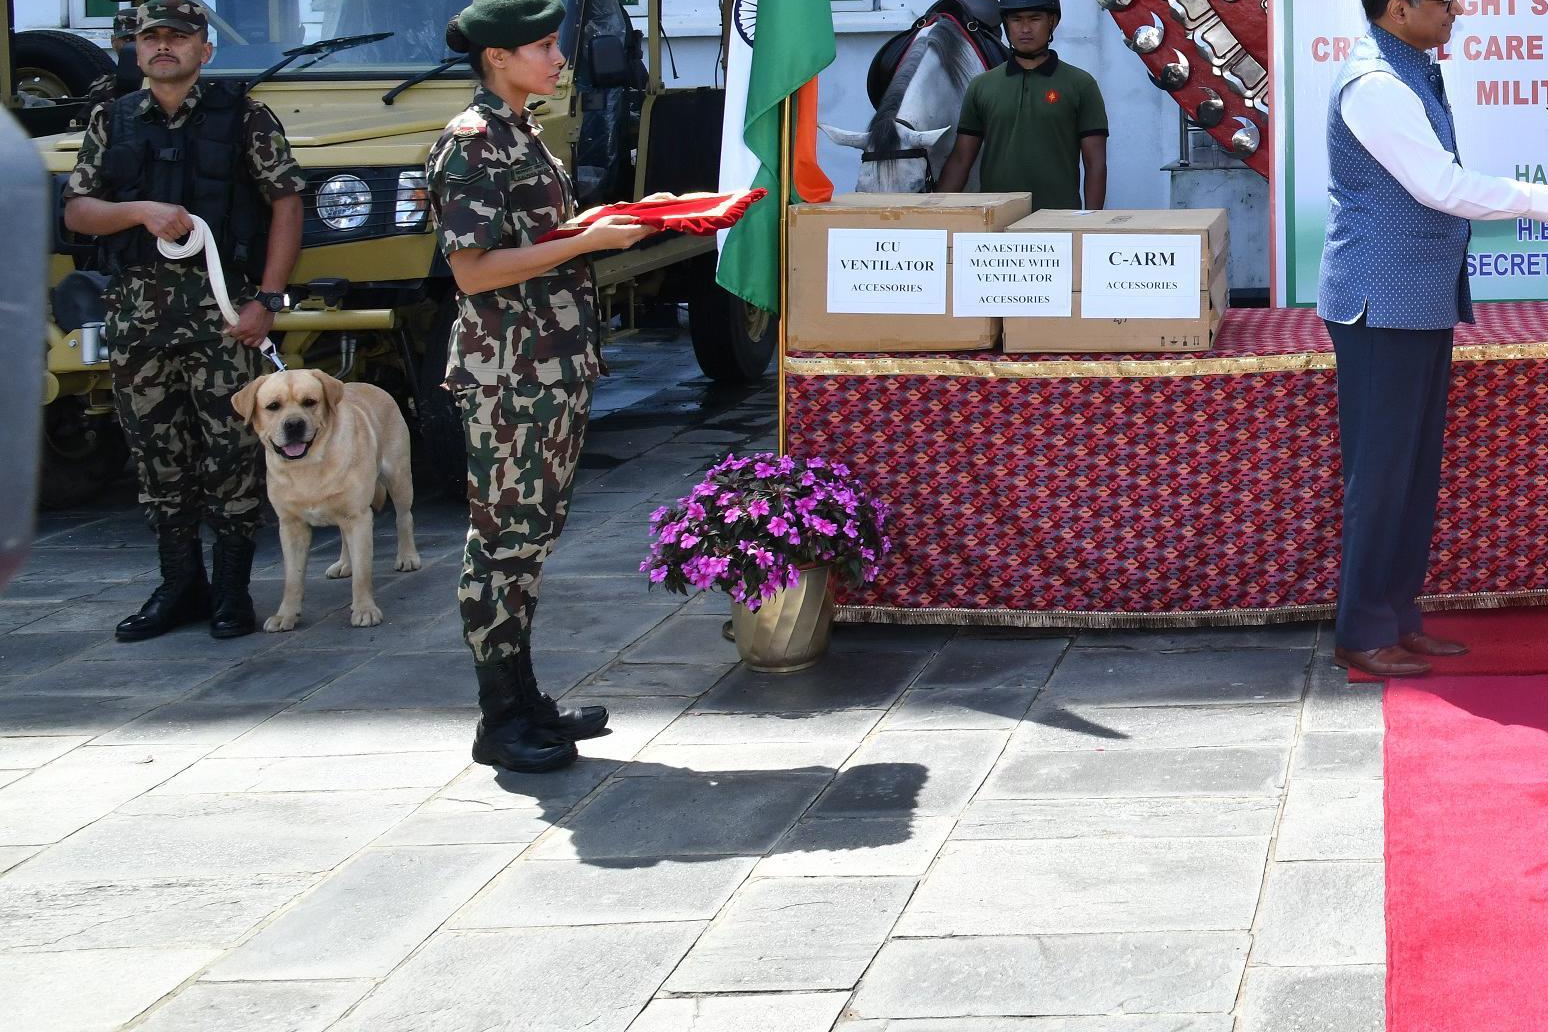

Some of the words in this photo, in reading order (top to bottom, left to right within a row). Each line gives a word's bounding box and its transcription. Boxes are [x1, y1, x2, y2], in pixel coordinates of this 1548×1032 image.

[1463, 35, 1544, 60] CARE
[876, 241, 901, 253] ICU
[974, 243, 1055, 253] ANAESTHESIA
[969, 258, 1026, 268] MACHINE
[1028, 258, 1060, 268] WITH
[1108, 251, 1177, 267] C-ARM
[840, 259, 935, 272] VENTILATOR
[977, 273, 1053, 283] VENTILATOR
[851, 283, 923, 293] ACCESSORIES
[1106, 281, 1179, 290] ACCESSORIES
[978, 295, 1050, 304] ACCESSORIES
